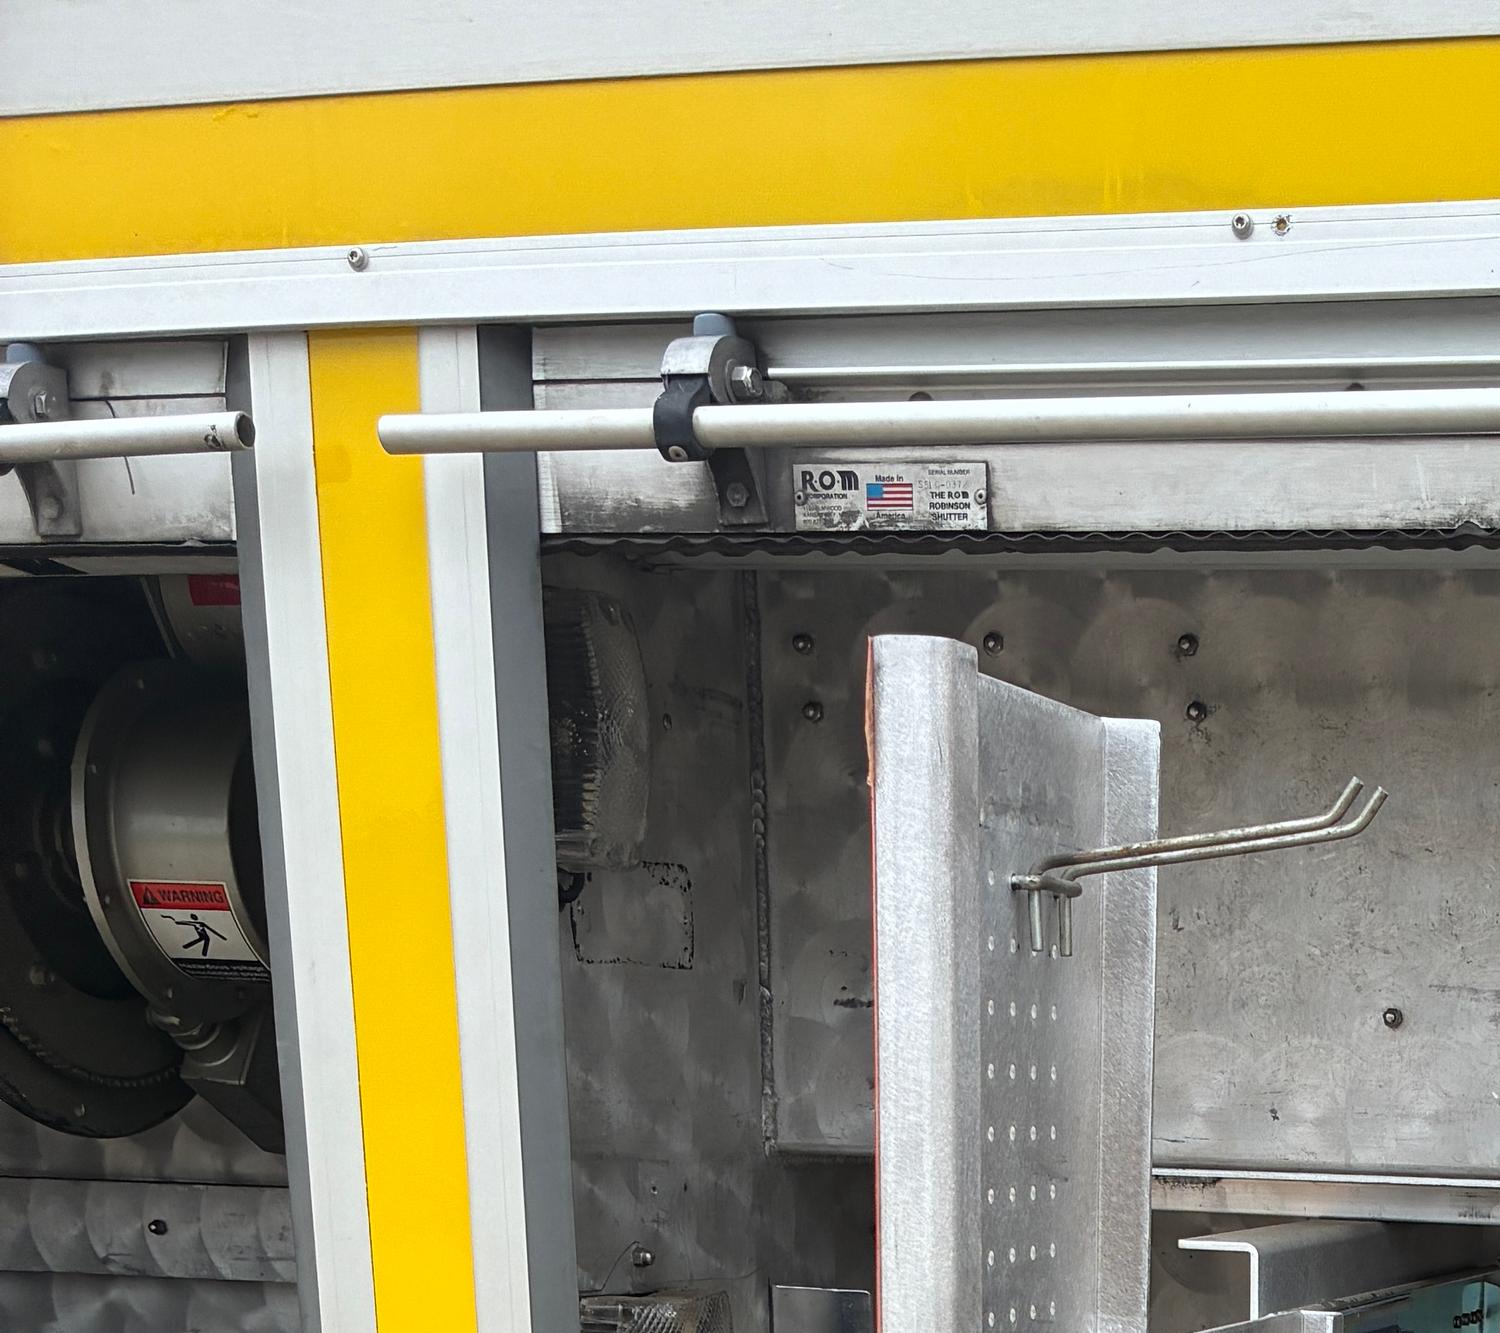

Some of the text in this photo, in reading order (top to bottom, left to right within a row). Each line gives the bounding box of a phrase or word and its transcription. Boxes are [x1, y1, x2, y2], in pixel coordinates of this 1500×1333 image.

[875, 474, 895, 482] Made
[929, 491, 946, 499] THE
[929, 502, 970, 510] ROBINSON
[931, 513, 968, 521] SHUTTER
[158, 888, 225, 904] WARNING
